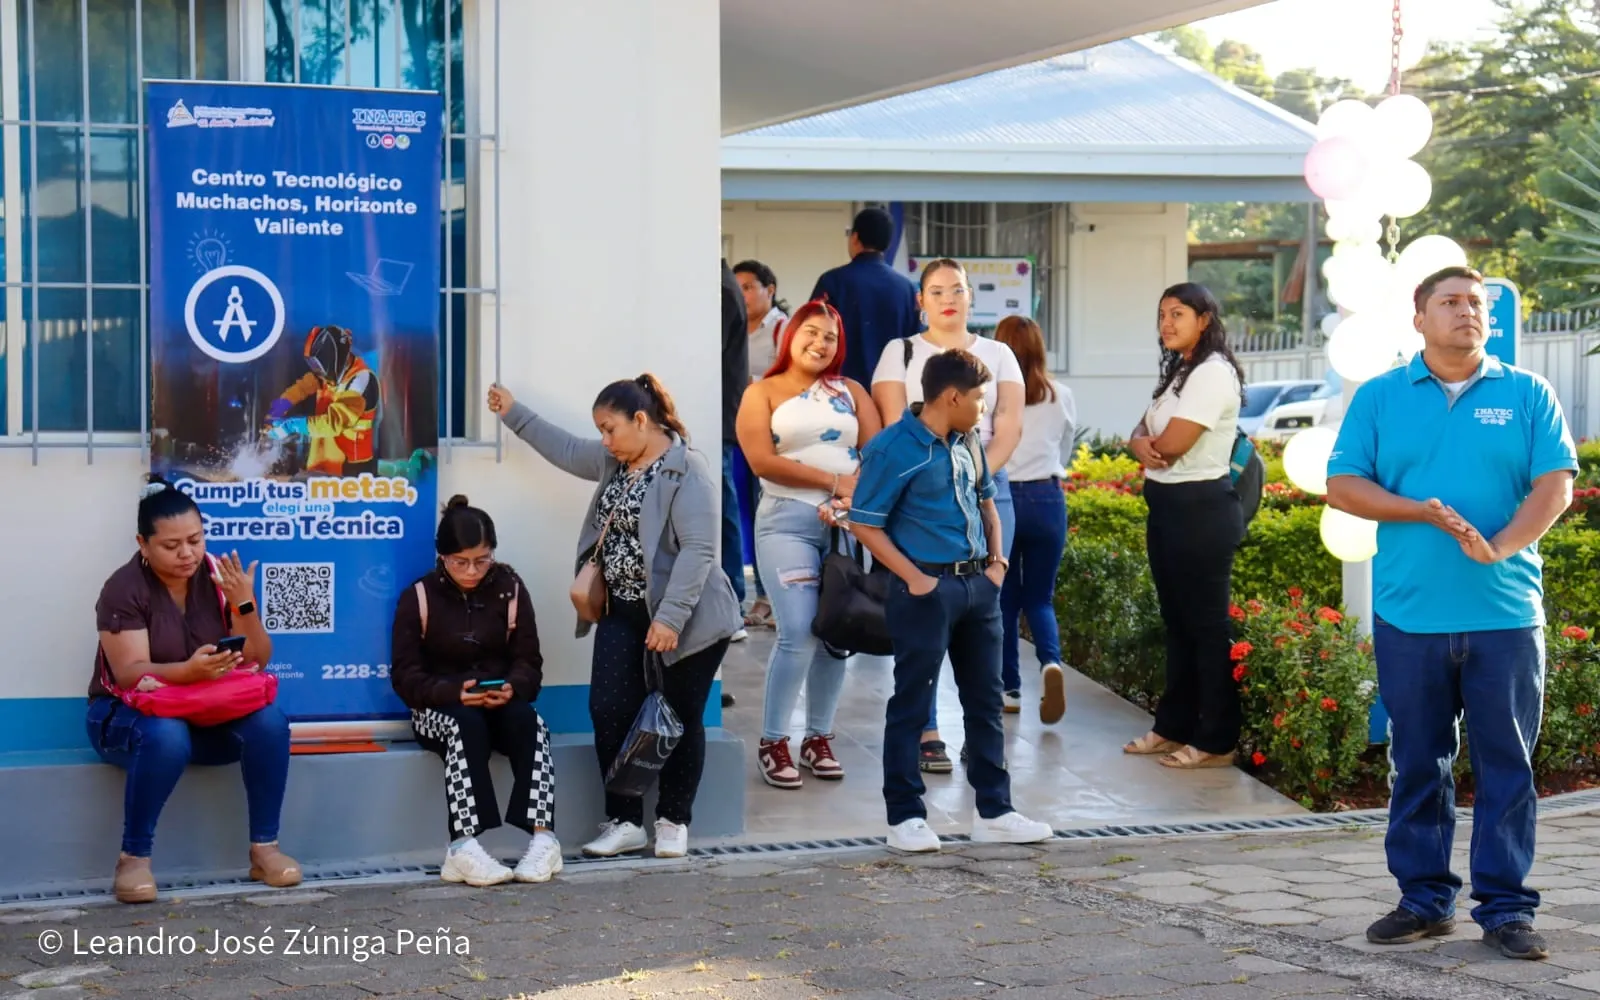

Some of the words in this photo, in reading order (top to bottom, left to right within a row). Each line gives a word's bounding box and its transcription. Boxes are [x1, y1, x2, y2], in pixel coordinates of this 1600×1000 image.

[352, 108, 427, 126] INATEC
[191, 168, 266, 188] Centro
[272, 170, 402, 193] Tecnológico
[176, 192, 308, 214] Muchachos,
[314, 195, 417, 215] Horizonte
[254, 217, 344, 236] Valiente
[266, 482, 304, 499] tus
[311, 478, 415, 502] metas,
[305, 504, 331, 513] una
[301, 514, 401, 536] Técnica
[265, 662, 293, 672] lógico
[321, 664, 392, 679] 2228-3
